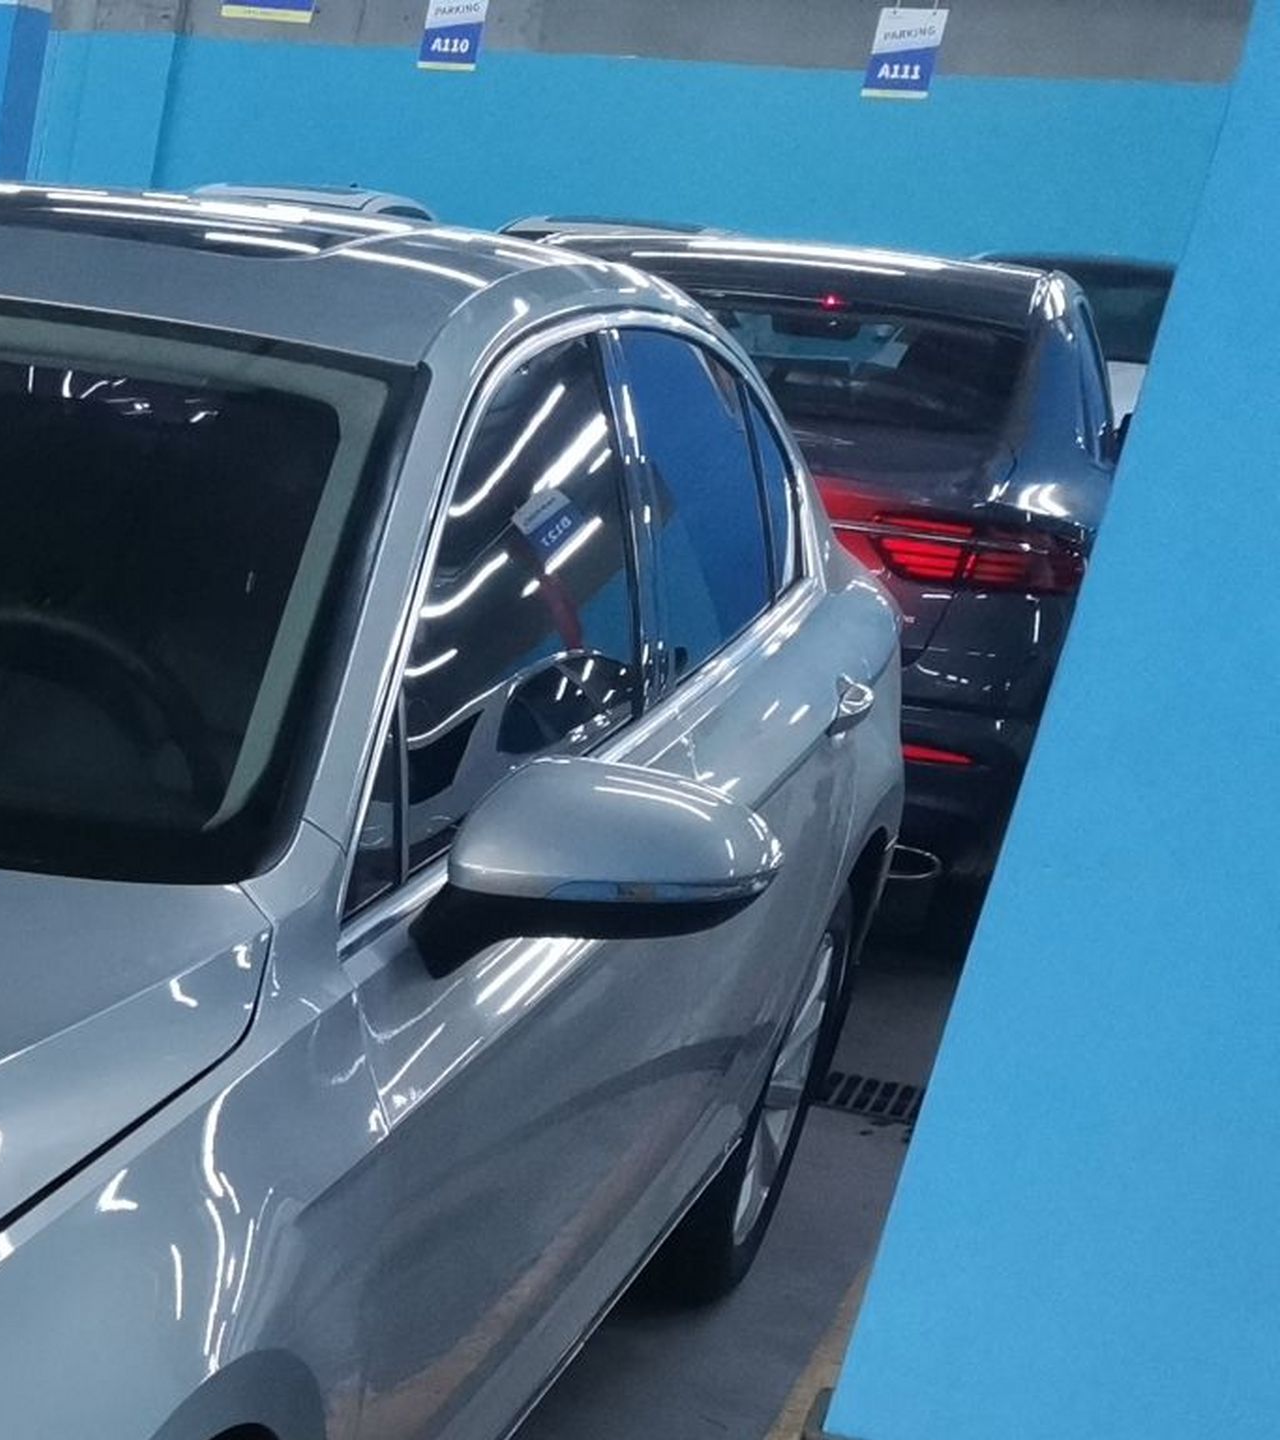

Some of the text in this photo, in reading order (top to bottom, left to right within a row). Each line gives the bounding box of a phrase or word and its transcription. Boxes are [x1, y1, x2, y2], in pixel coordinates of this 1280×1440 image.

[883, 25, 937, 41] PARKING
[430, 37, 470, 53] A110
[877, 63, 921, 80] A111
